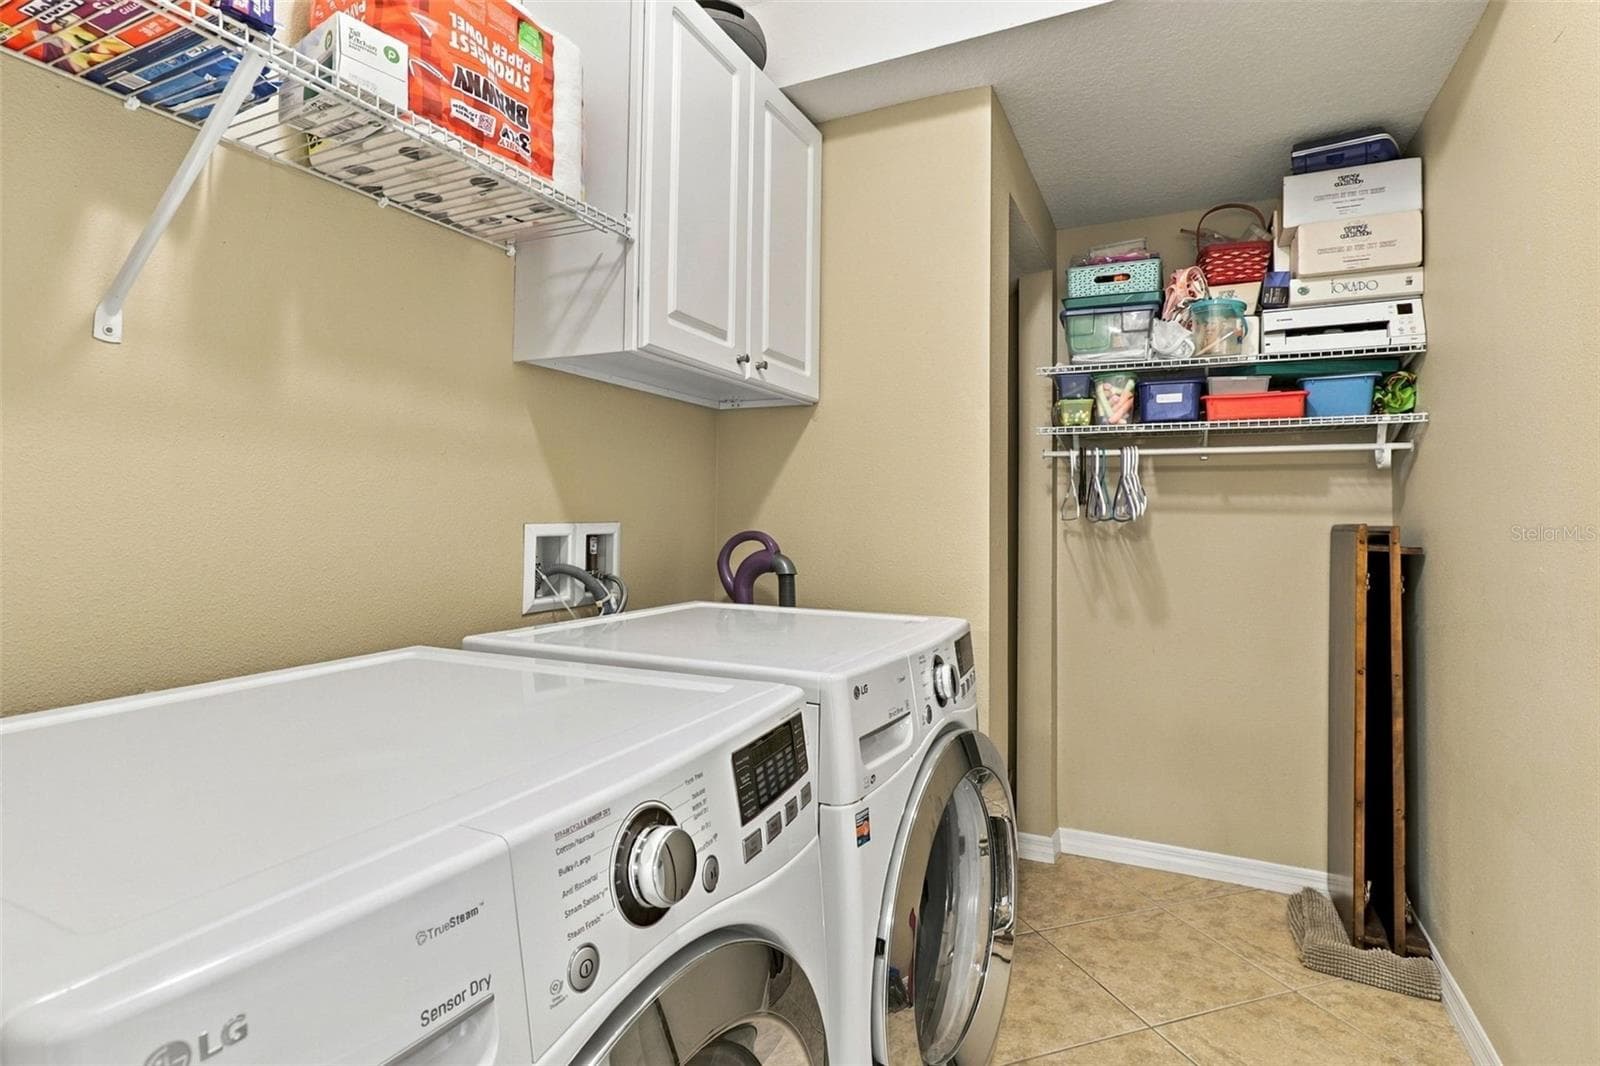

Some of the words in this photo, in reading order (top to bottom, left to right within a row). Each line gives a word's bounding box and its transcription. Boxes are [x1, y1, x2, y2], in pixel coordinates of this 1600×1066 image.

[448, 11, 490, 51] TOWEL
[449, 31, 530, 93] STRONGEST
[492, 41, 531, 75] PAPER
[452, 64, 530, 131] BRAWNY
[420, 989, 467, 1028] Sensor
[470, 974, 492, 997] Dry
[198, 1013, 248, 1062] LG
